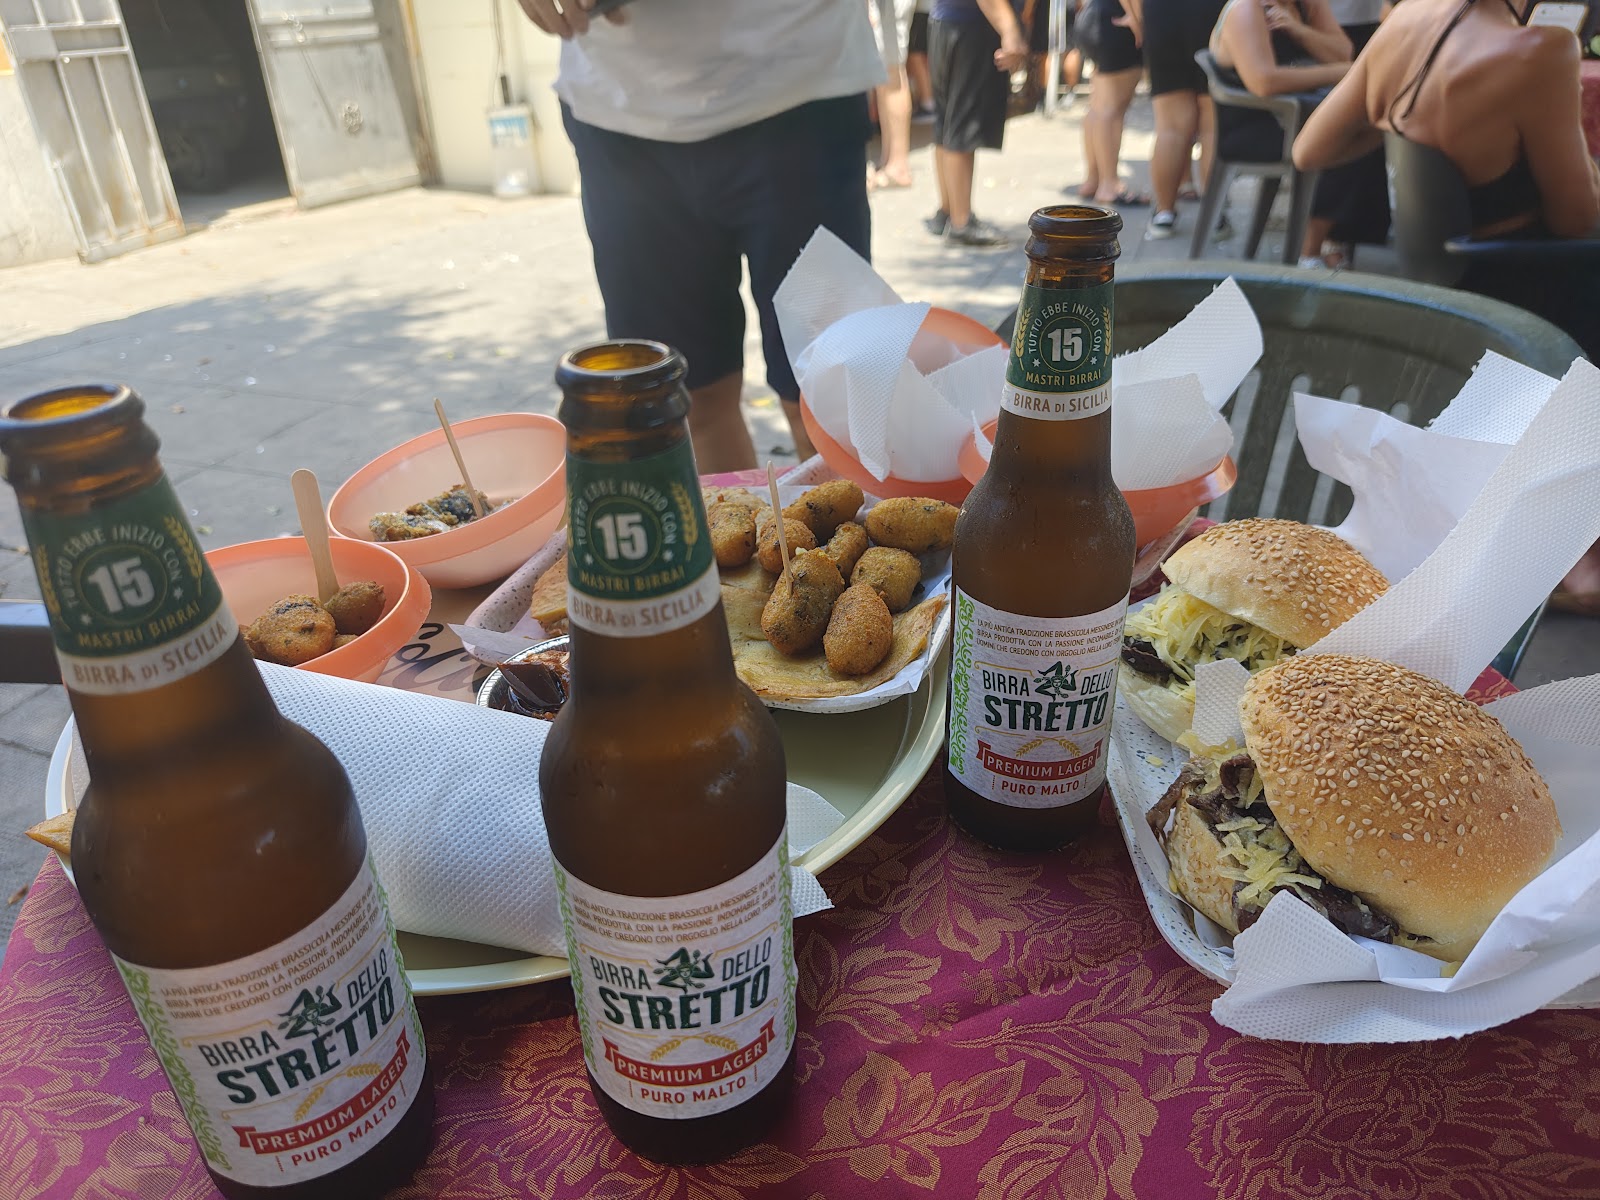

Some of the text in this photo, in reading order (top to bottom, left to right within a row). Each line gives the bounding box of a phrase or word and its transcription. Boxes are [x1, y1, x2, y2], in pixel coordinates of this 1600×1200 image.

[1029, 302, 1102, 353] TUTTO EBBE INIZIO CON
[1048, 328, 1082, 362] 15
[1014, 393, 1050, 413] BIRRA
[1069, 389, 1108, 412] SICILIA
[1026, 369, 1101, 386] MASTRI BIRRAI
[574, 480, 677, 546] TUTTO EBBE INIZIO CON
[595, 512, 648, 560] 15
[57, 524, 183, 608] TUTTO EBBE INIZIO CON
[88, 556, 155, 614] 15
[579, 565, 686, 592] MASTRI BIRRAI
[78, 601, 200, 648] MASTRI BIRRAI
[573, 596, 616, 627] BIRRA
[640, 590, 705, 626] SICILIA
[73, 664, 135, 685] BIRRA
[162, 620, 228, 673] SICILIA
[982, 668, 1114, 697] BIRRA DELLO
[984, 691, 1109, 732] STRETTO
[987, 755, 1094, 777] PREMIUM LAGER
[1001, 779, 1079, 796] PURO MALTO
[590, 936, 772, 991] BIRRA DELLO
[199, 948, 388, 1067] BIRRA DELLO
[598, 965, 771, 1030] STRETTO
[216, 976, 395, 1104] STRETTO
[618, 1042, 763, 1083] PREMIUM LAGER
[258, 1057, 405, 1150] PREMIUM LAGER
[641, 1075, 747, 1105] PURO MALTO
[292, 1093, 398, 1167] PURO MALTO
